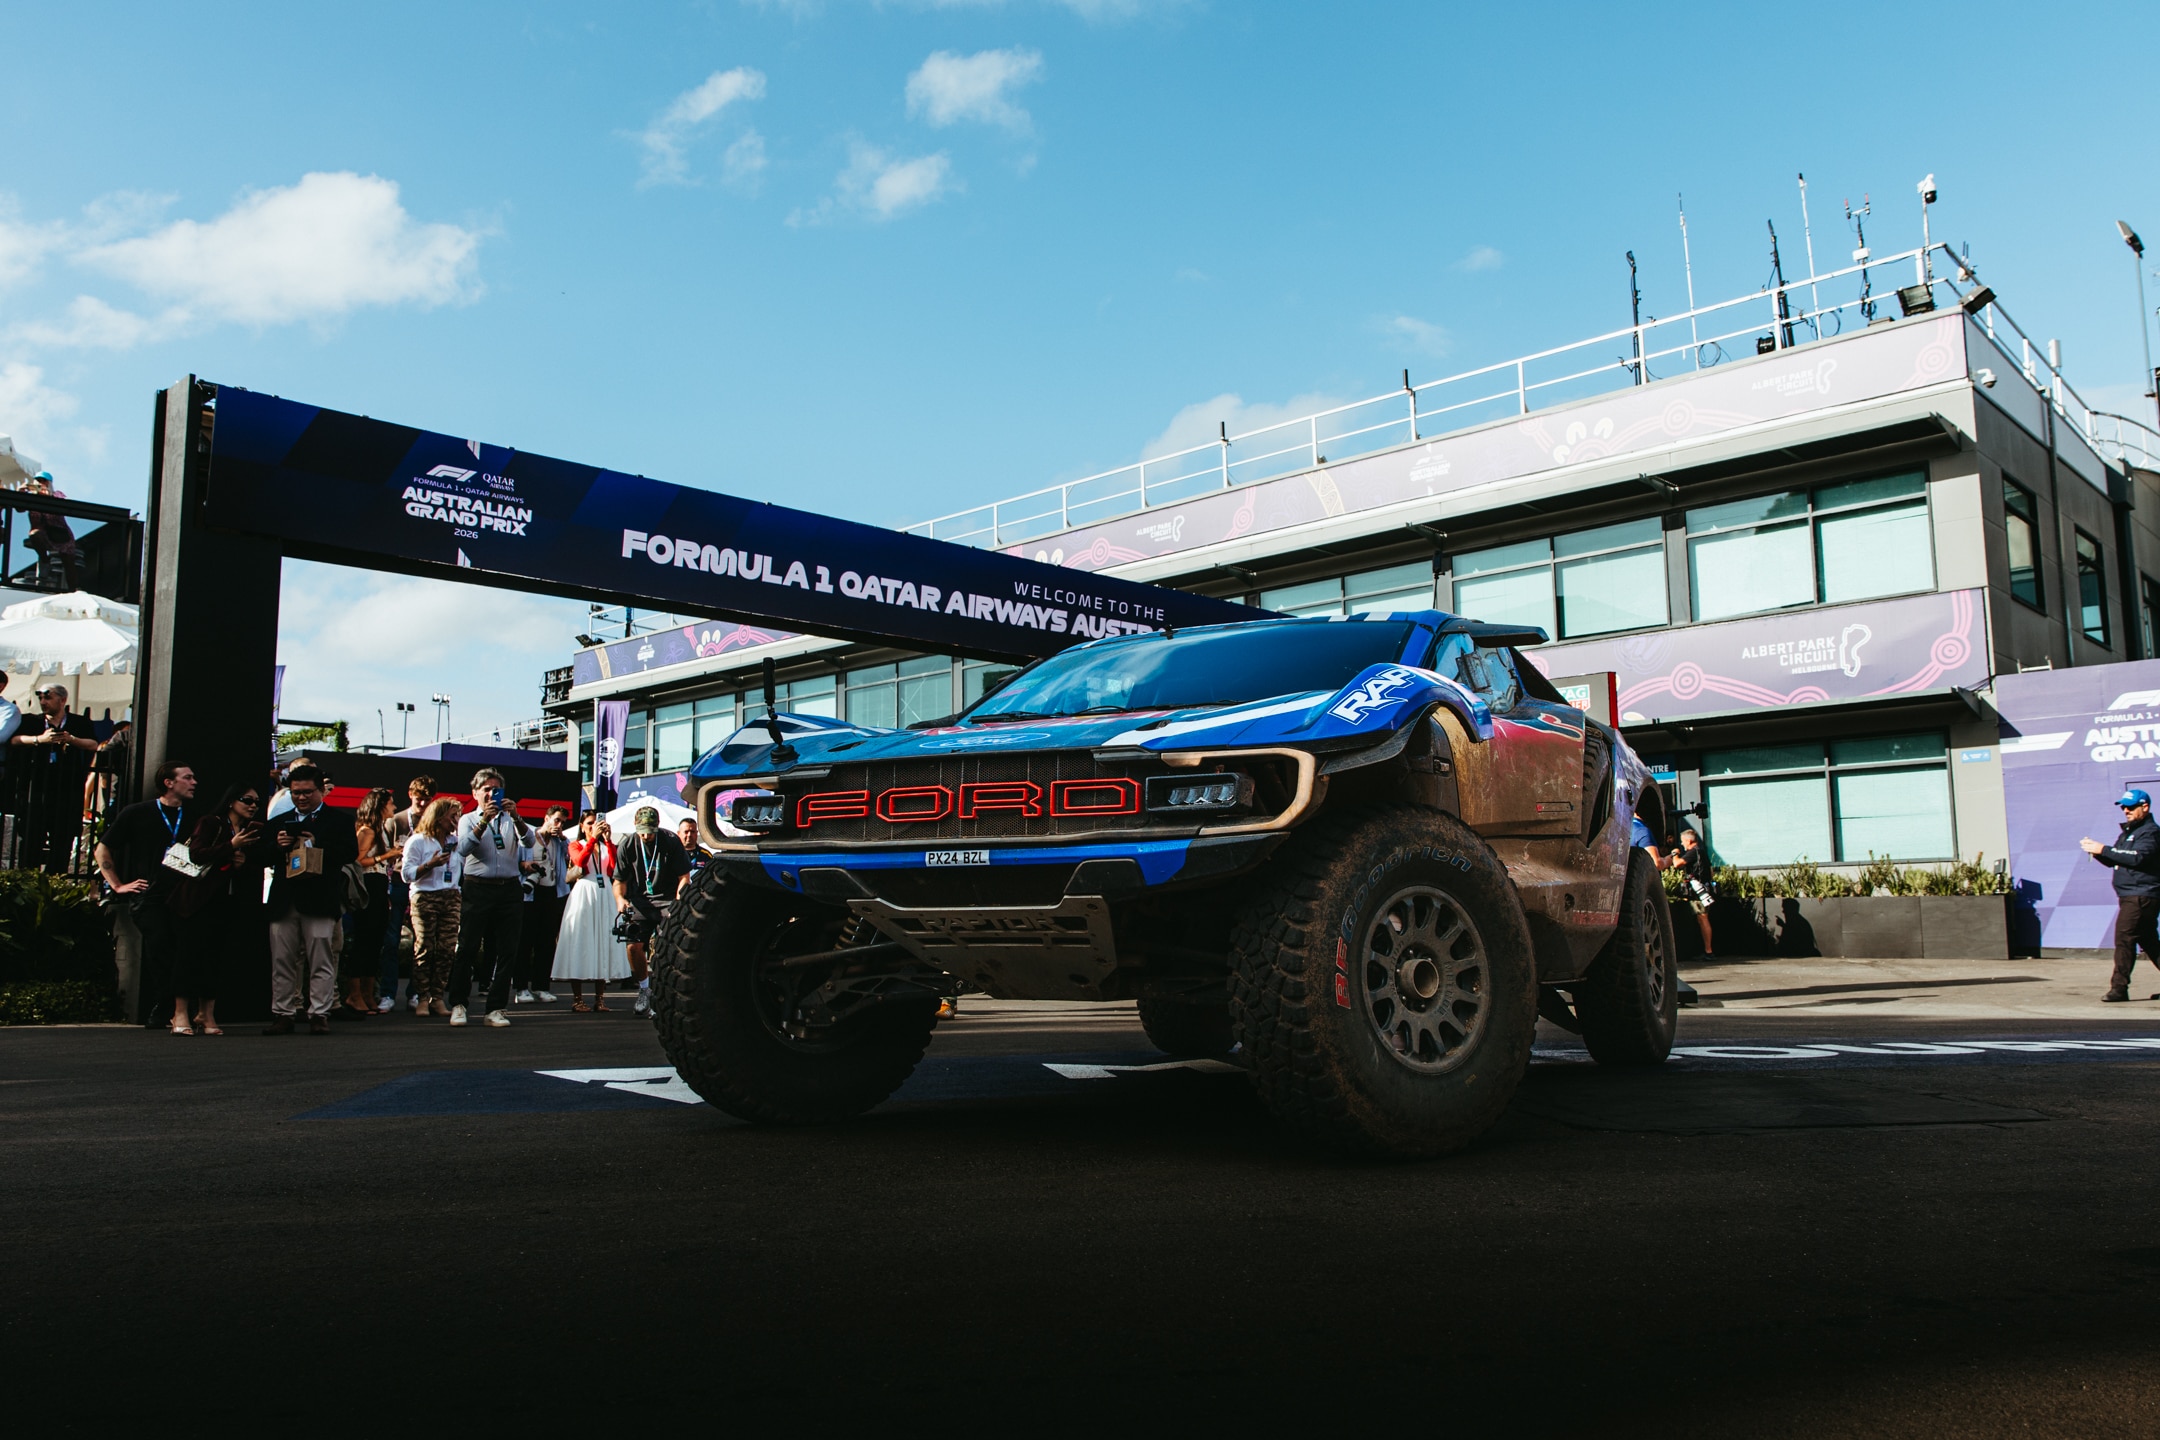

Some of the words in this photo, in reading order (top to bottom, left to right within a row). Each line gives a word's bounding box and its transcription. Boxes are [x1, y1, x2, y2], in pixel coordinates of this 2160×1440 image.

[413, 476, 453, 490] FORMULA
[454, 484, 460, 492] 1
[465, 487, 490, 497] QATAR
[491, 492, 525, 505] AIRWAYS
[482, 472, 515, 487] QATAR
[402, 486, 533, 523] AUSTRALIAN
[405, 501, 478, 527] GRAND
[480, 515, 527, 536] PRIX
[454, 528, 479, 539] 2026
[622, 528, 810, 590] FORMULA
[815, 565, 834, 594] 1
[839, 570, 942, 613] QATAR
[944, 591, 1068, 633] AIRWAYS
[1070, 613, 1166, 639] AUST
[1014, 581, 1103, 610] WELCOME
[1108, 599, 1129, 615] TO
[1133, 604, 1165, 622] THE
[1742, 641, 1795, 659] ALBERT
[1798, 636, 1836, 652] PARK
[1779, 648, 1837, 667] CIRCUIT
[1791, 662, 1838, 674] MELBOURNE
[2094, 713, 2144, 724] FORMULA
[797, 778, 1142, 828] FORD
[928, 852, 959, 866] PX24
[963, 850, 987, 865] BZL
